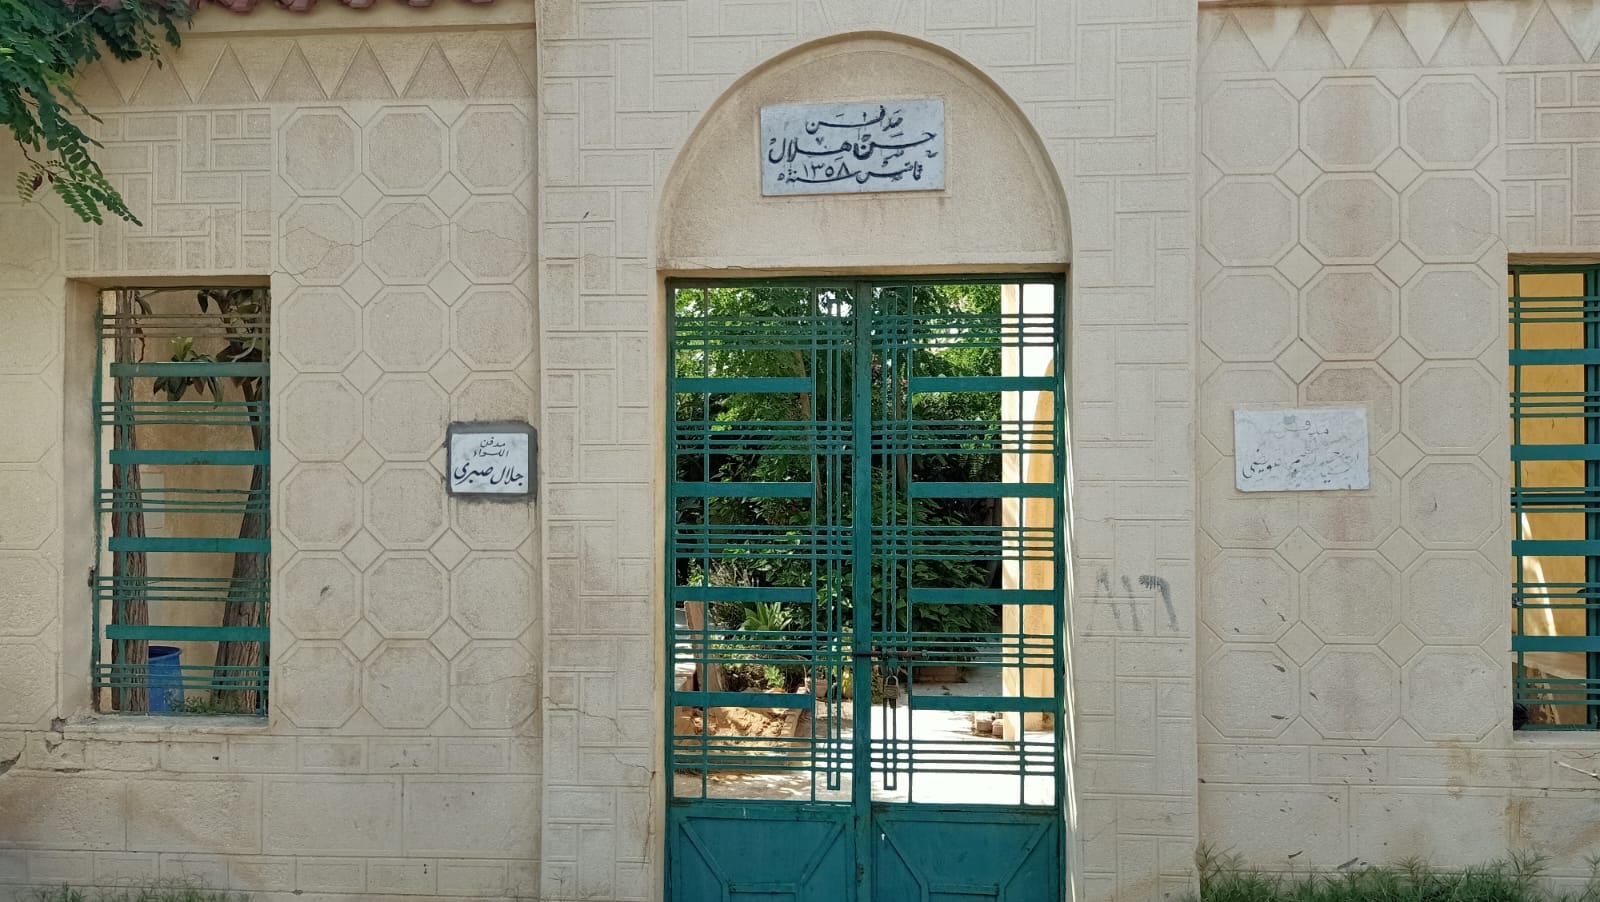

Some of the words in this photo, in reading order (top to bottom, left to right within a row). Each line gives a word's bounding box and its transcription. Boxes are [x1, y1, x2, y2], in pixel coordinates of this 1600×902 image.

[805, 105, 904, 134] مدفن
[803, 161, 850, 179] ١٣٥٨
[480, 436, 506, 448] مدفن
[490, 466, 524, 486] جلال
